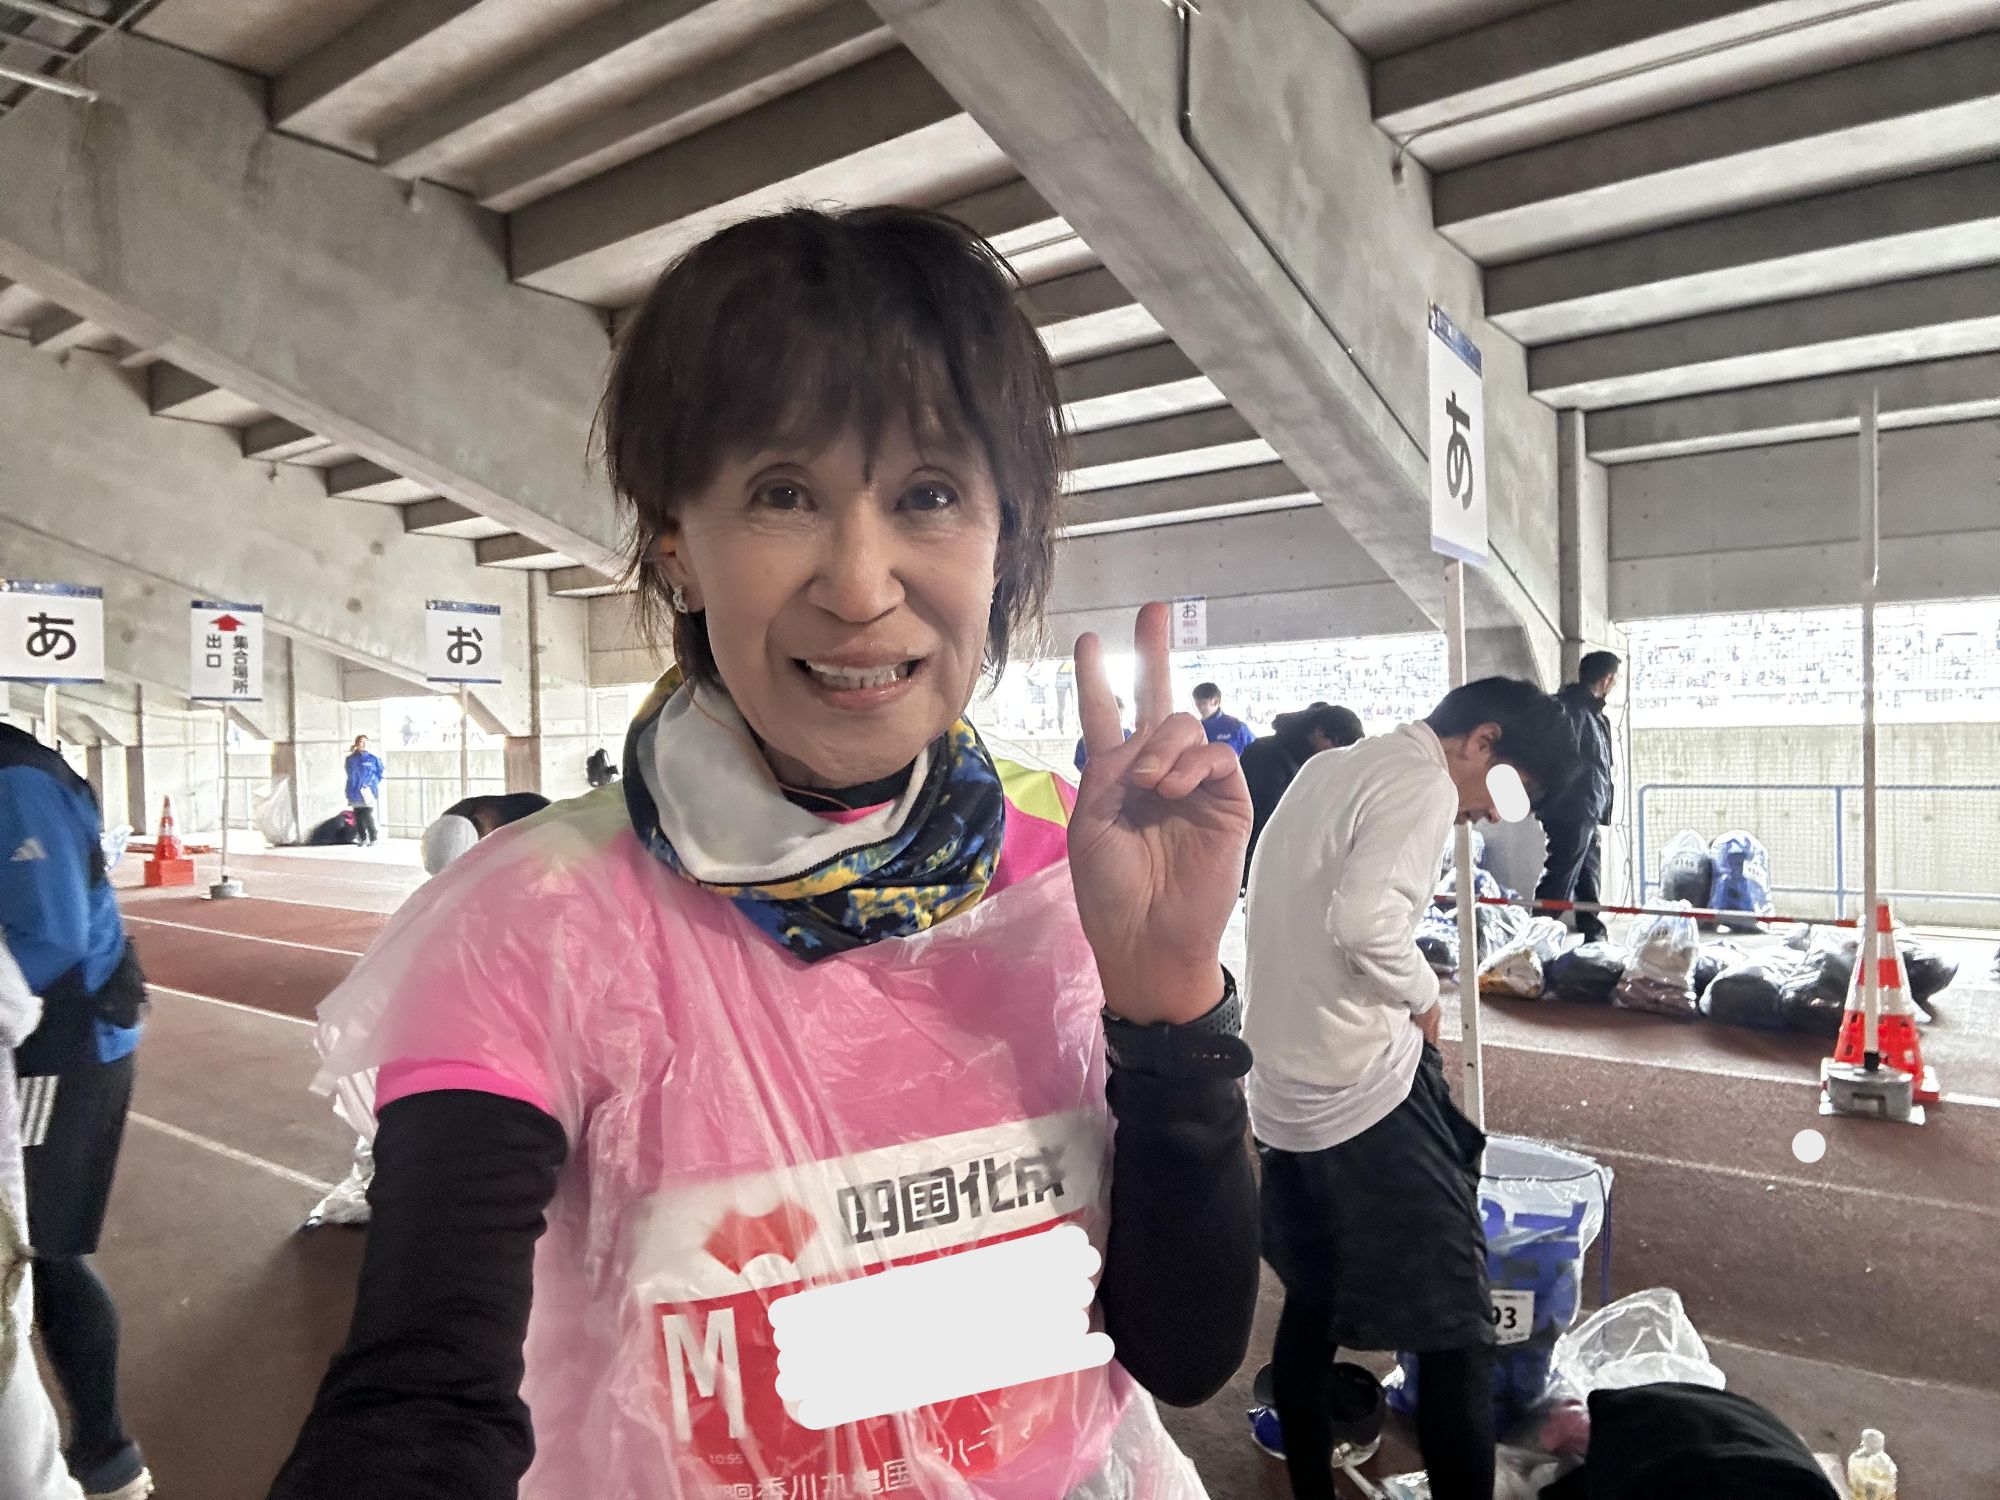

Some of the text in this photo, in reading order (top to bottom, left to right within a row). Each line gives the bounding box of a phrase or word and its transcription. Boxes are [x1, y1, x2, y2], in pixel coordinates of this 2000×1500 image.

[1446, 390, 1474, 511] あ
[26, 611, 77, 661] あ
[206, 634, 222, 668] 出口
[446, 626, 483, 665] お
[232, 635, 248, 695] 集合場所
[662, 1307, 747, 1441] M
